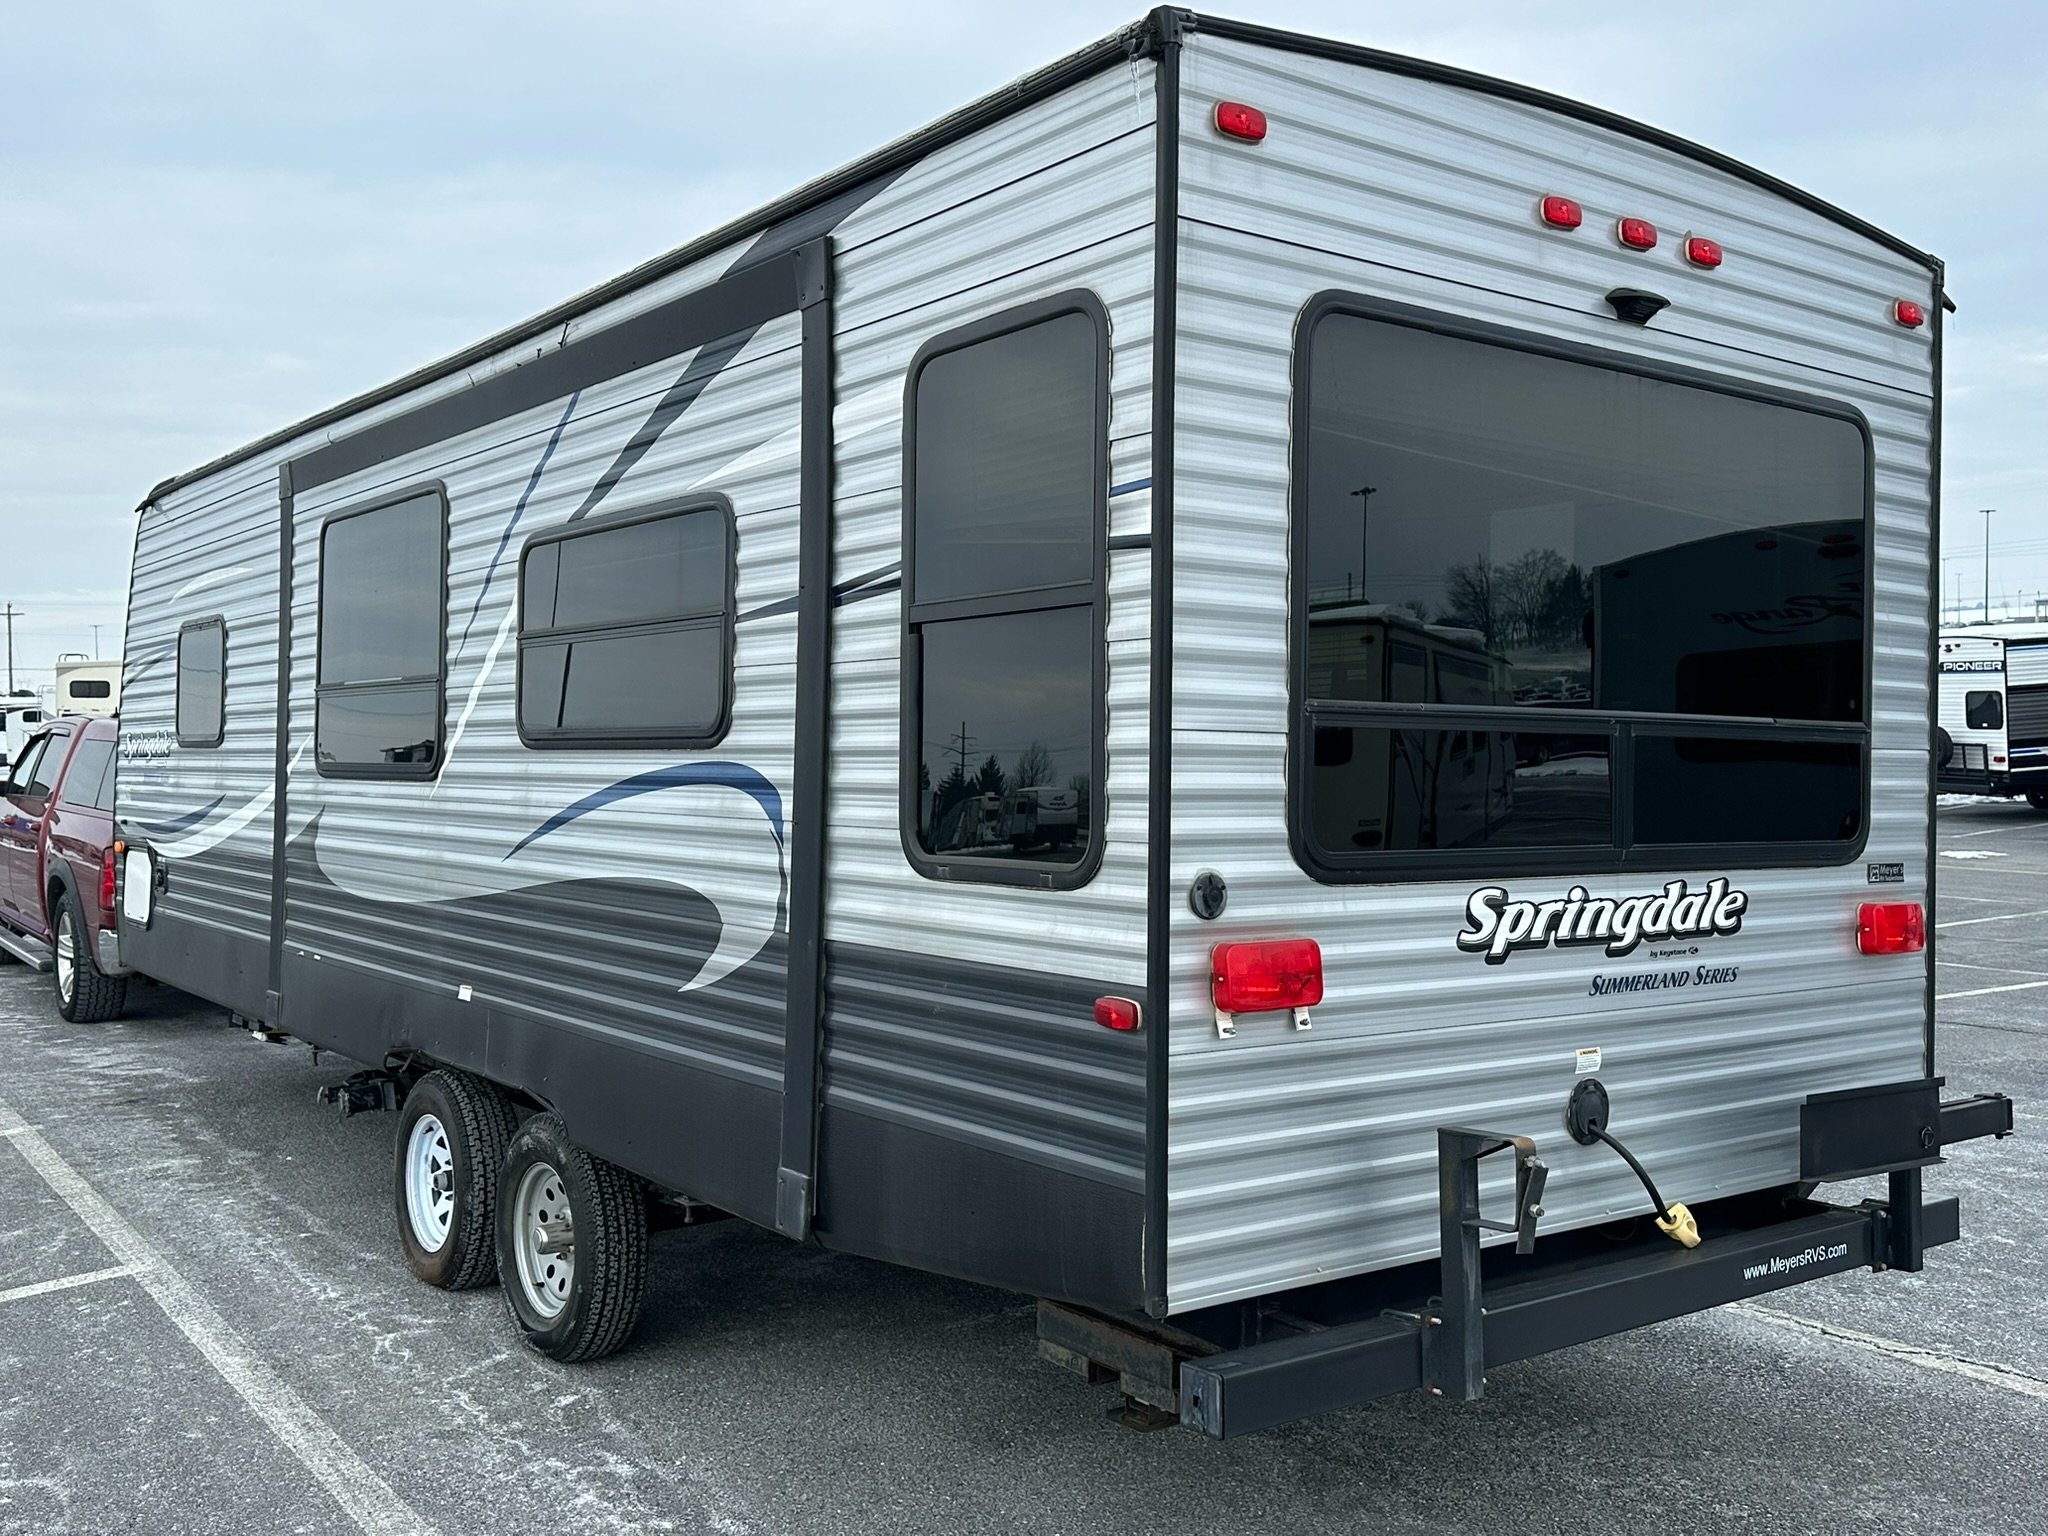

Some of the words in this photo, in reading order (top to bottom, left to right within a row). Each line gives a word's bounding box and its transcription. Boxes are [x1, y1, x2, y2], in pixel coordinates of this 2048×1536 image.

[1943, 661, 2003, 672] PIONEER
[124, 730, 172, 761] Springdale
[1457, 877, 1748, 965] Springdale
[1588, 974, 1690, 997] SUMMERLAND
[1693, 965, 1739, 986] SERIES
[1743, 1243, 1848, 1280] www.MeyersRVS.com
